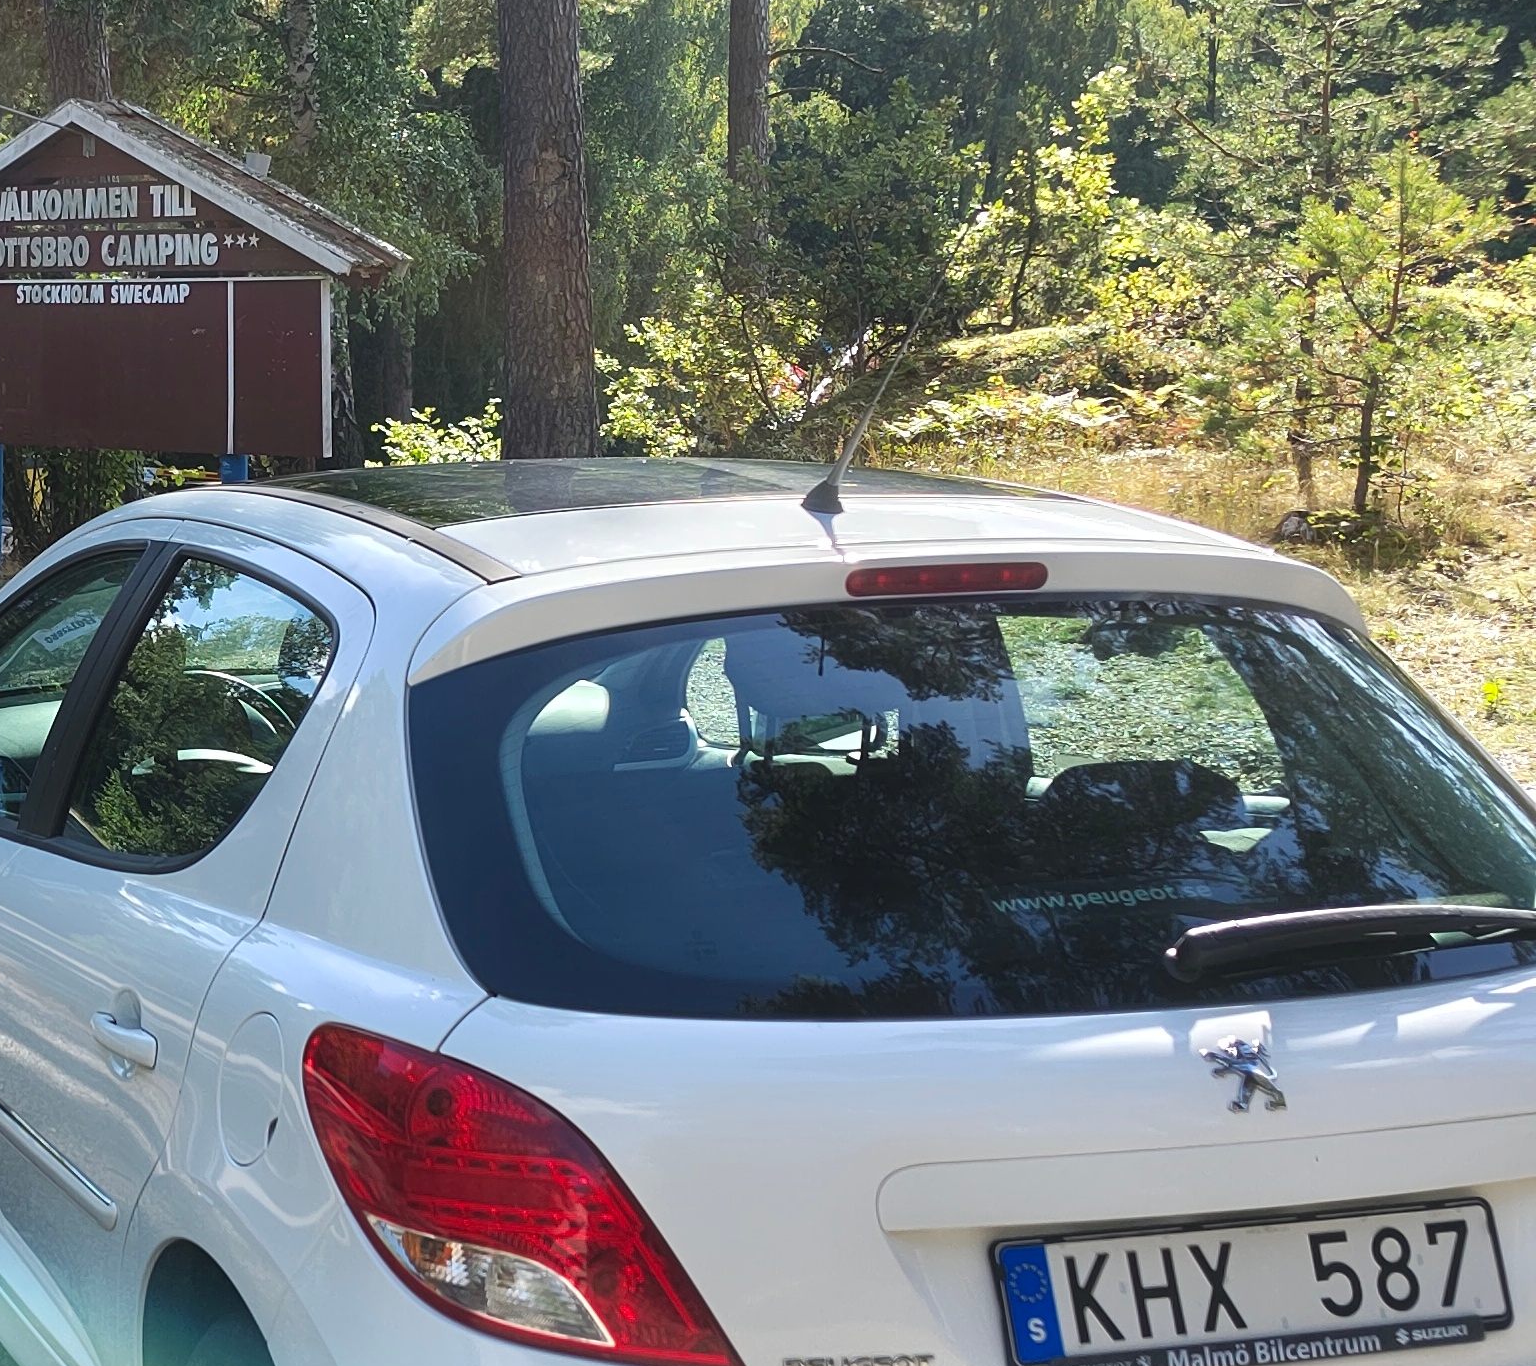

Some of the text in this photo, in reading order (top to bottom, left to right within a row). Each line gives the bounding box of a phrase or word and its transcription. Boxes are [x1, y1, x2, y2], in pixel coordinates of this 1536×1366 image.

[150, 185, 197, 218] TILL
[101, 233, 218, 267] CAMPING
[16, 283, 190, 304] STOCKHOLM SWECAMP
[992, 884, 1213, 913] www.peugeot.se
[1028, 1220, 1468, 1345] S KHX 587
[1257, 1333, 1382, 1366] Bilcentrum
[1412, 1324, 1469, 1341] SUZUKI
